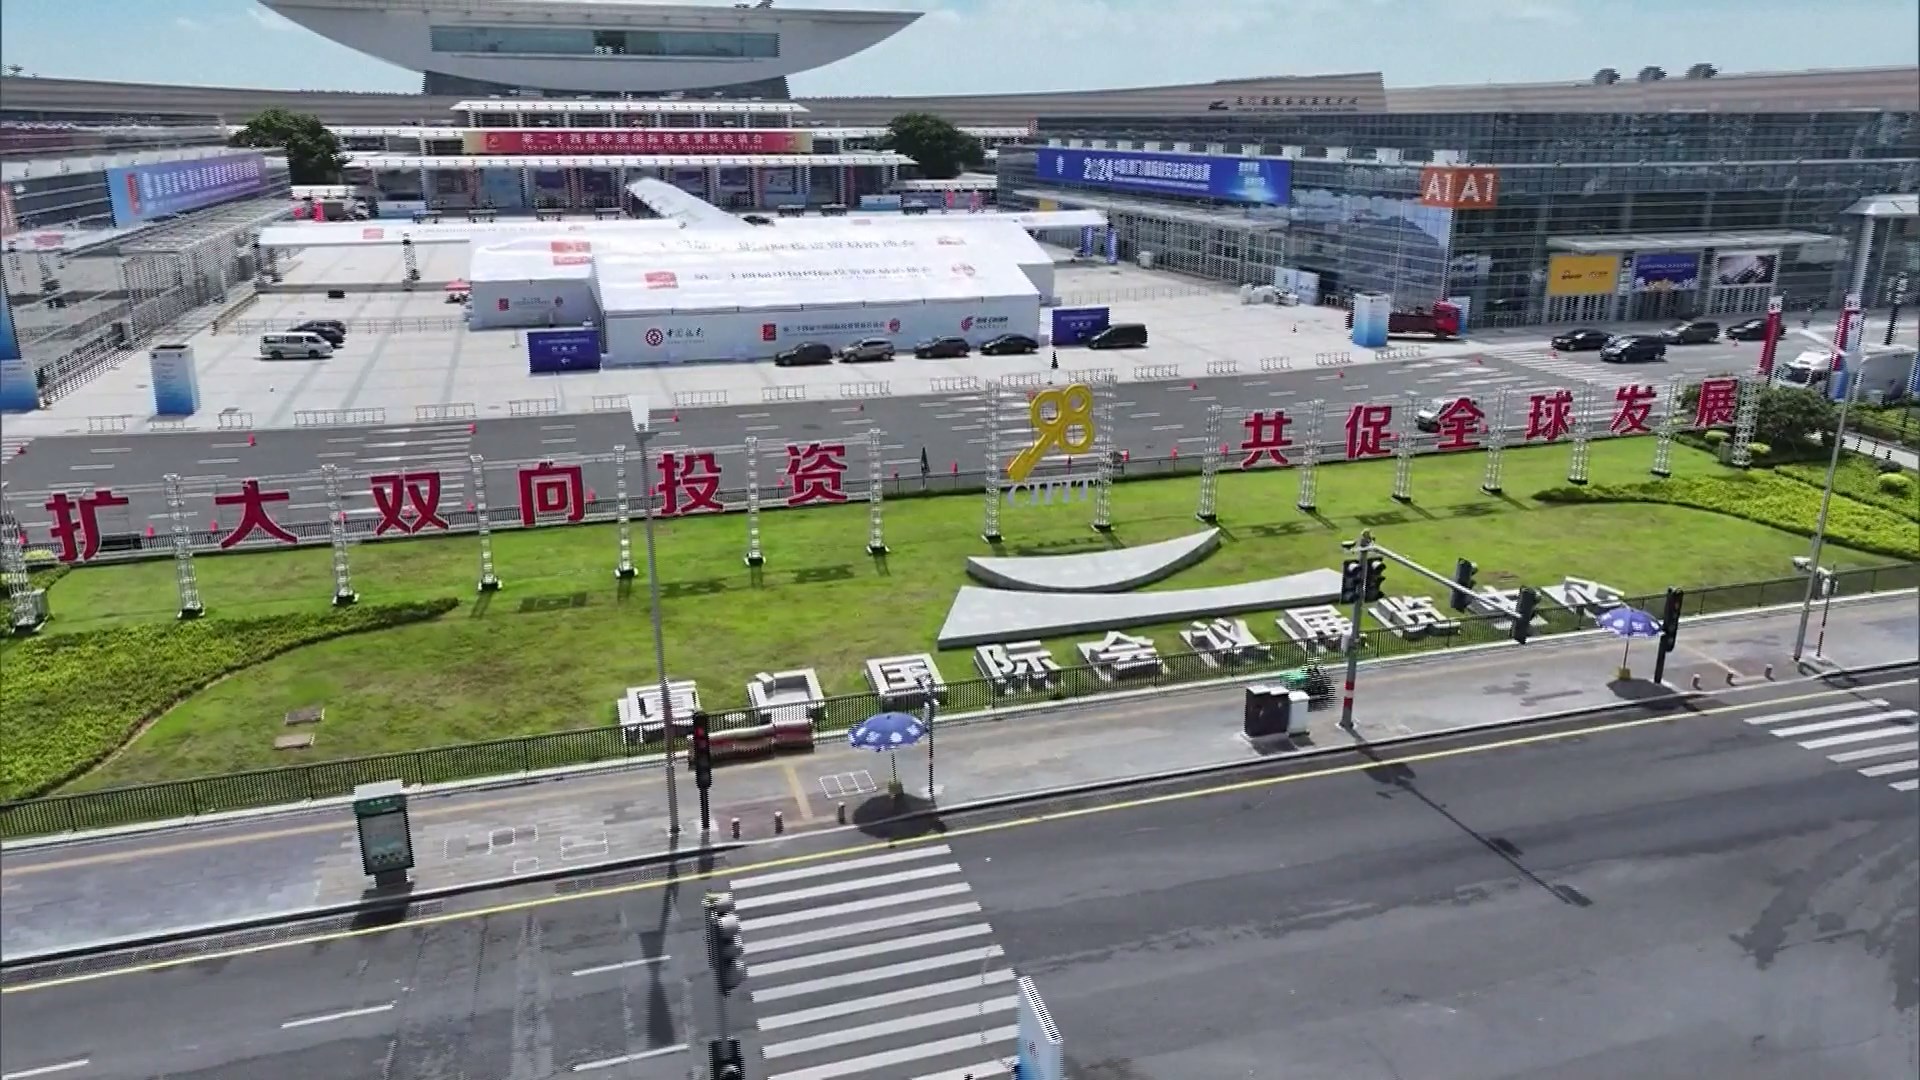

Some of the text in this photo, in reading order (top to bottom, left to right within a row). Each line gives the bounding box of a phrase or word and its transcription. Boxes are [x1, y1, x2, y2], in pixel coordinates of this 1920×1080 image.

[1424, 172, 1453, 201] A1
[1457, 173, 1496, 203] A1
[45, 377, 1740, 562] 扩大双向投资 共促全球发展
